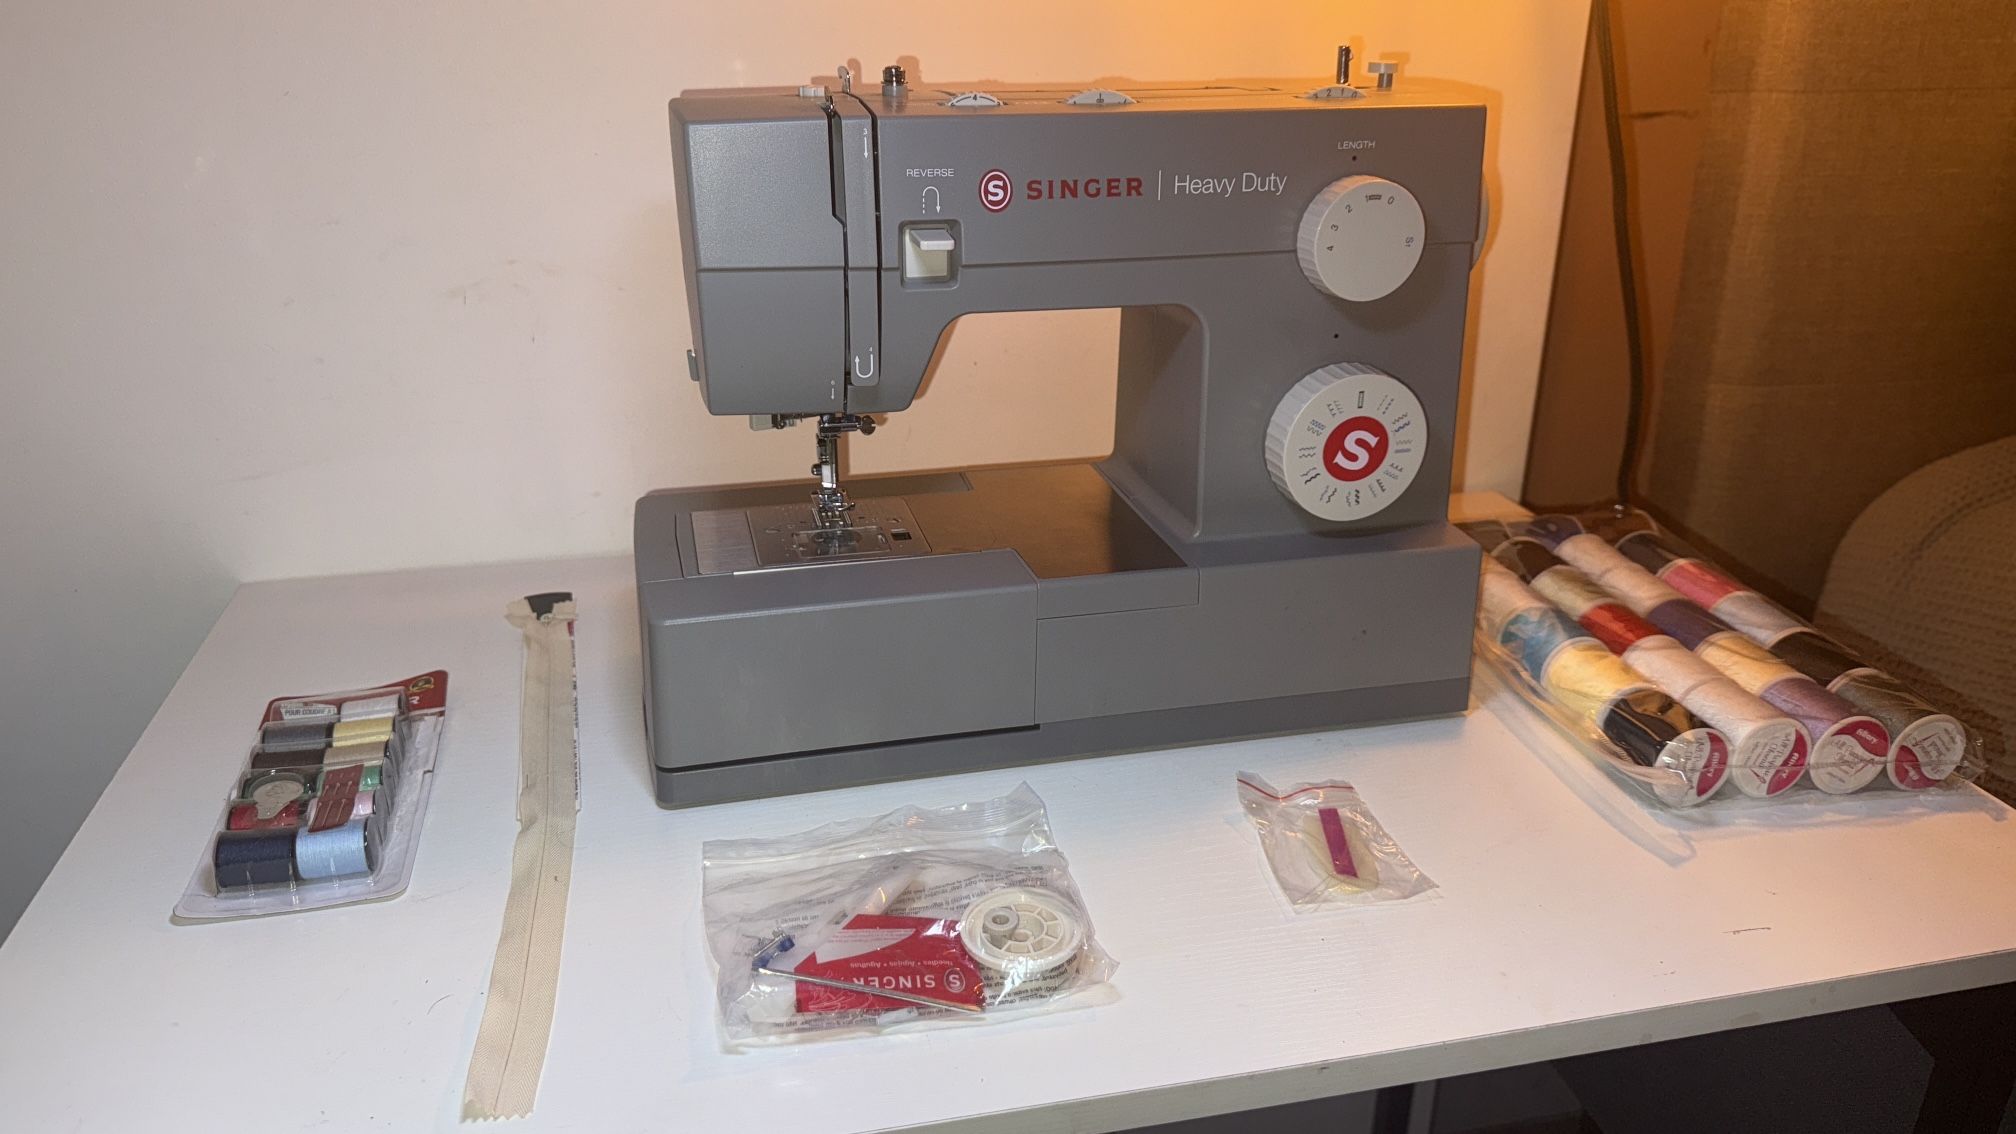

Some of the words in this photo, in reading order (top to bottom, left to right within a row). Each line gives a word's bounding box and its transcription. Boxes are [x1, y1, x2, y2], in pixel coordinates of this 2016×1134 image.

[1337, 140, 1376, 150] LENGTH
[906, 168, 955, 178] REVERSE
[1026, 177, 1144, 200] SINGER
[1174, 174, 1236, 198] Heavy
[1241, 172, 1288, 196] Duty
[1345, 204, 1353, 213] 2
[1330, 223, 1339, 232] 3
[1333, 429, 1380, 471] S
